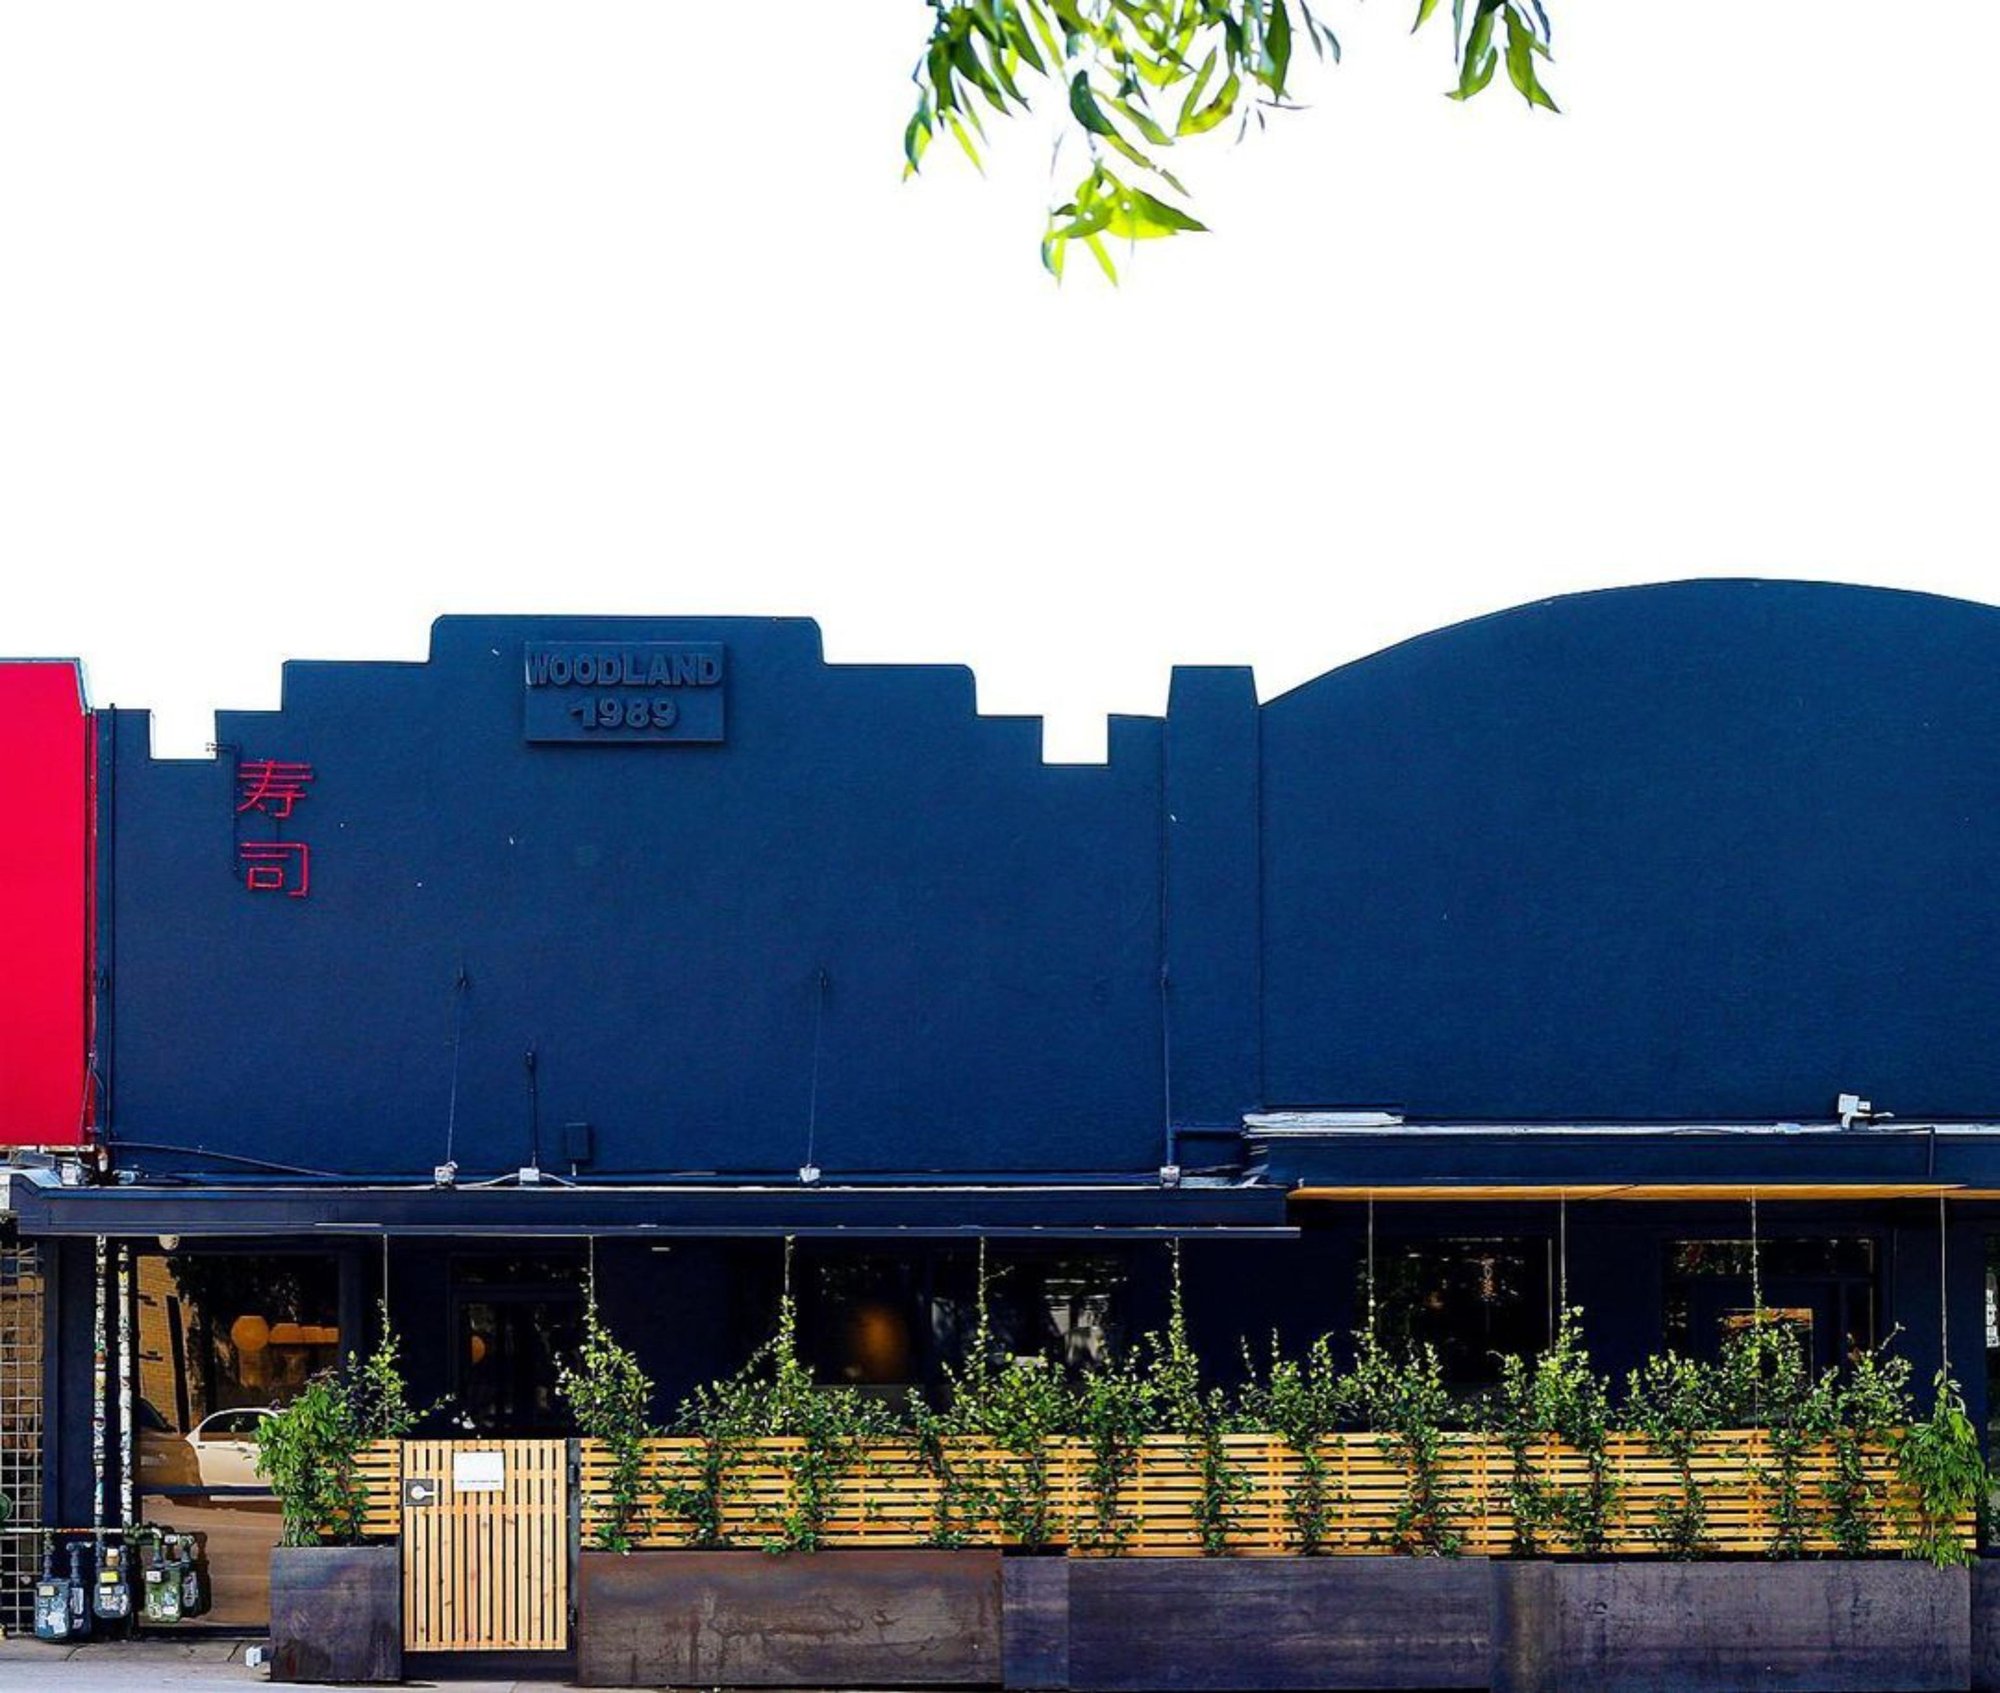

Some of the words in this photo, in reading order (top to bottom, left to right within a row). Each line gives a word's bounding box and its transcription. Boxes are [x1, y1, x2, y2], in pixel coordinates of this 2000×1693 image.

[525, 652, 723, 686] WOODLAND
[571, 697, 678, 728] 1989
[238, 760, 313, 897] 寿司
